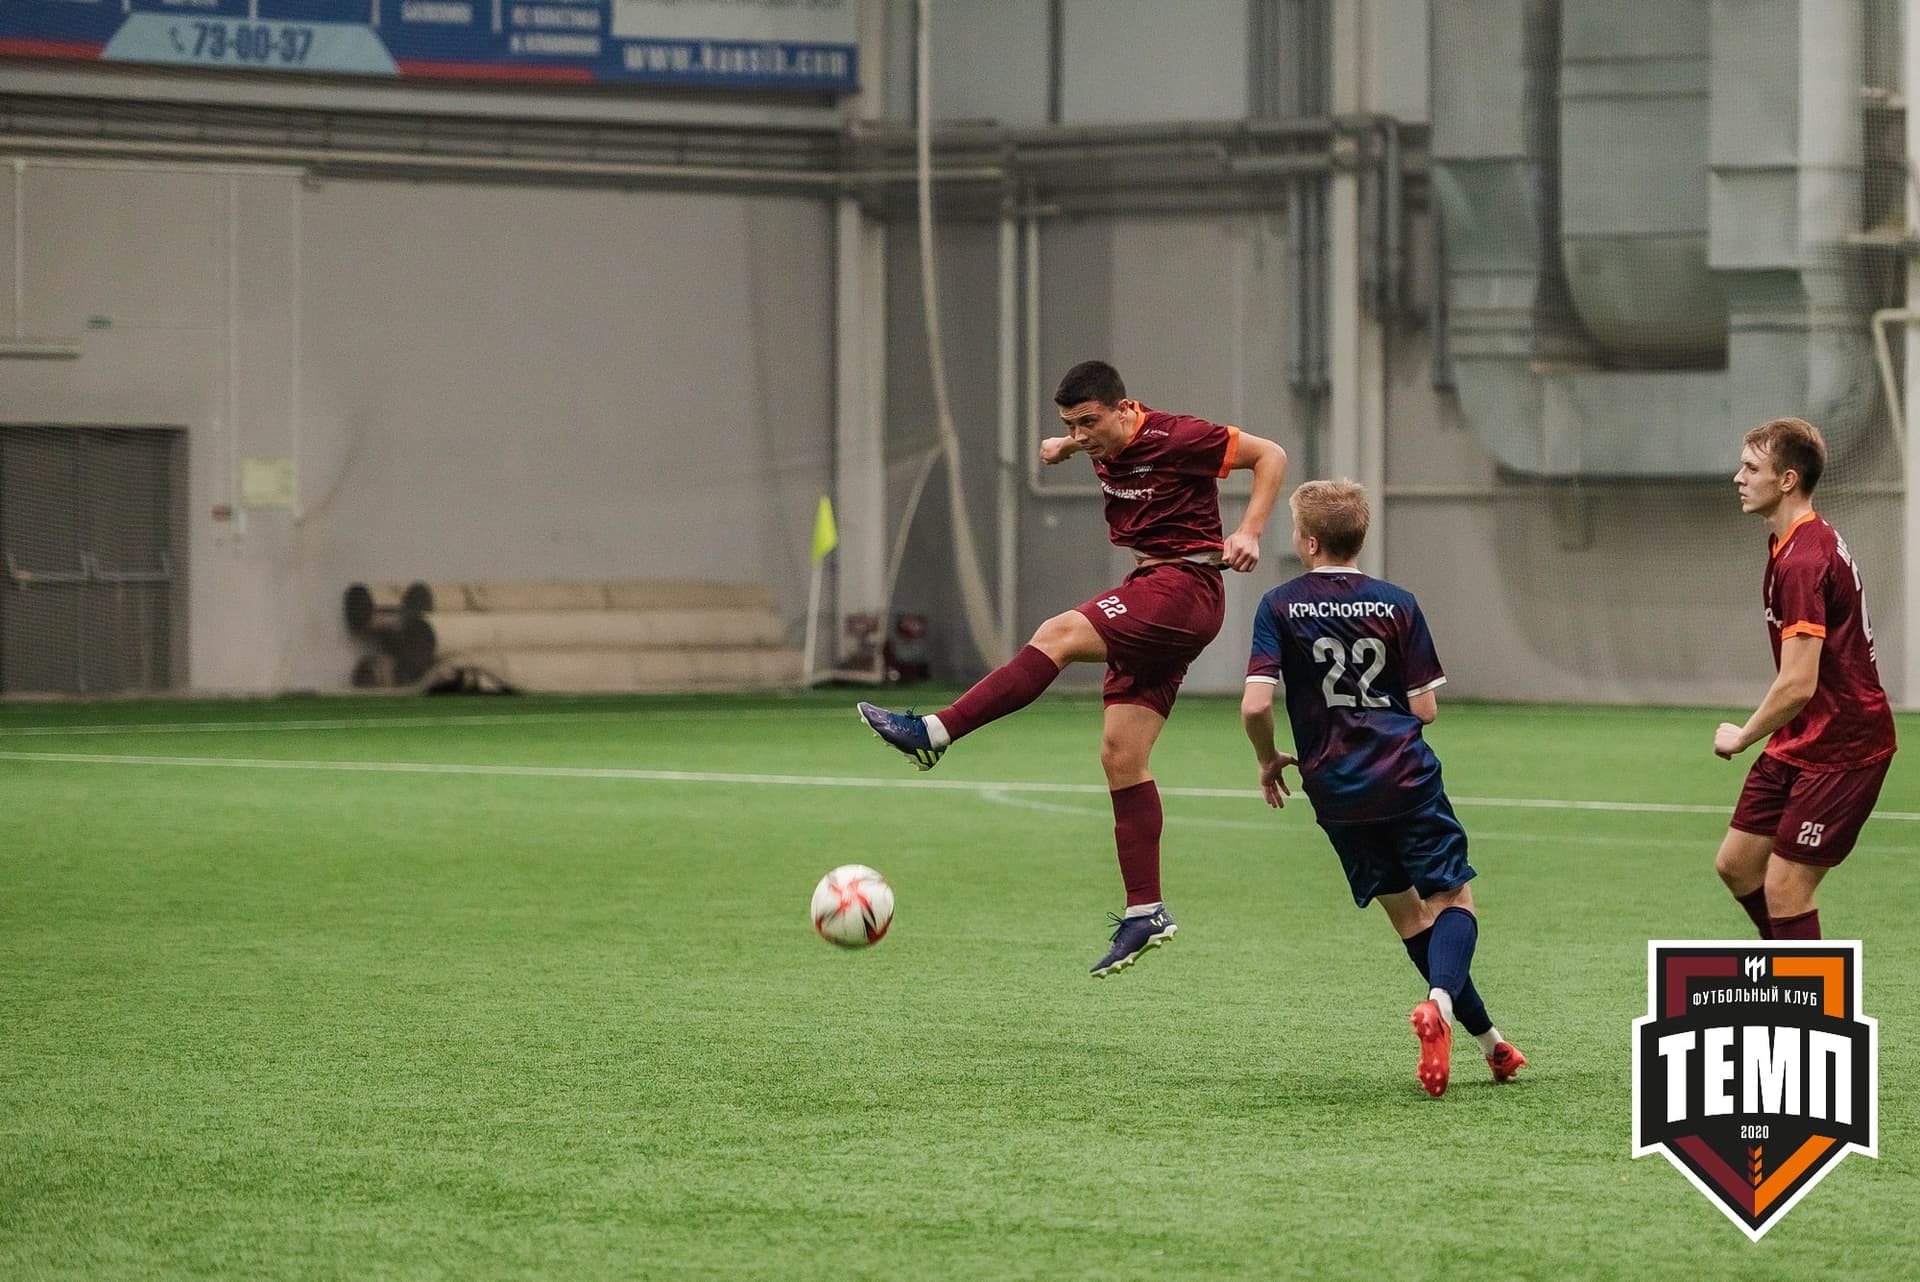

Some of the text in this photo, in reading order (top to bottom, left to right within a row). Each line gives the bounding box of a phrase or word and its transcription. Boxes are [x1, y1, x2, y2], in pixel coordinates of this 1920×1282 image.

[1096, 595, 1128, 619] 22
[1288, 601, 1395, 619] КРАСНОЯРСК
[1312, 637, 1392, 708] 22
[1796, 820, 1826, 847] 25
